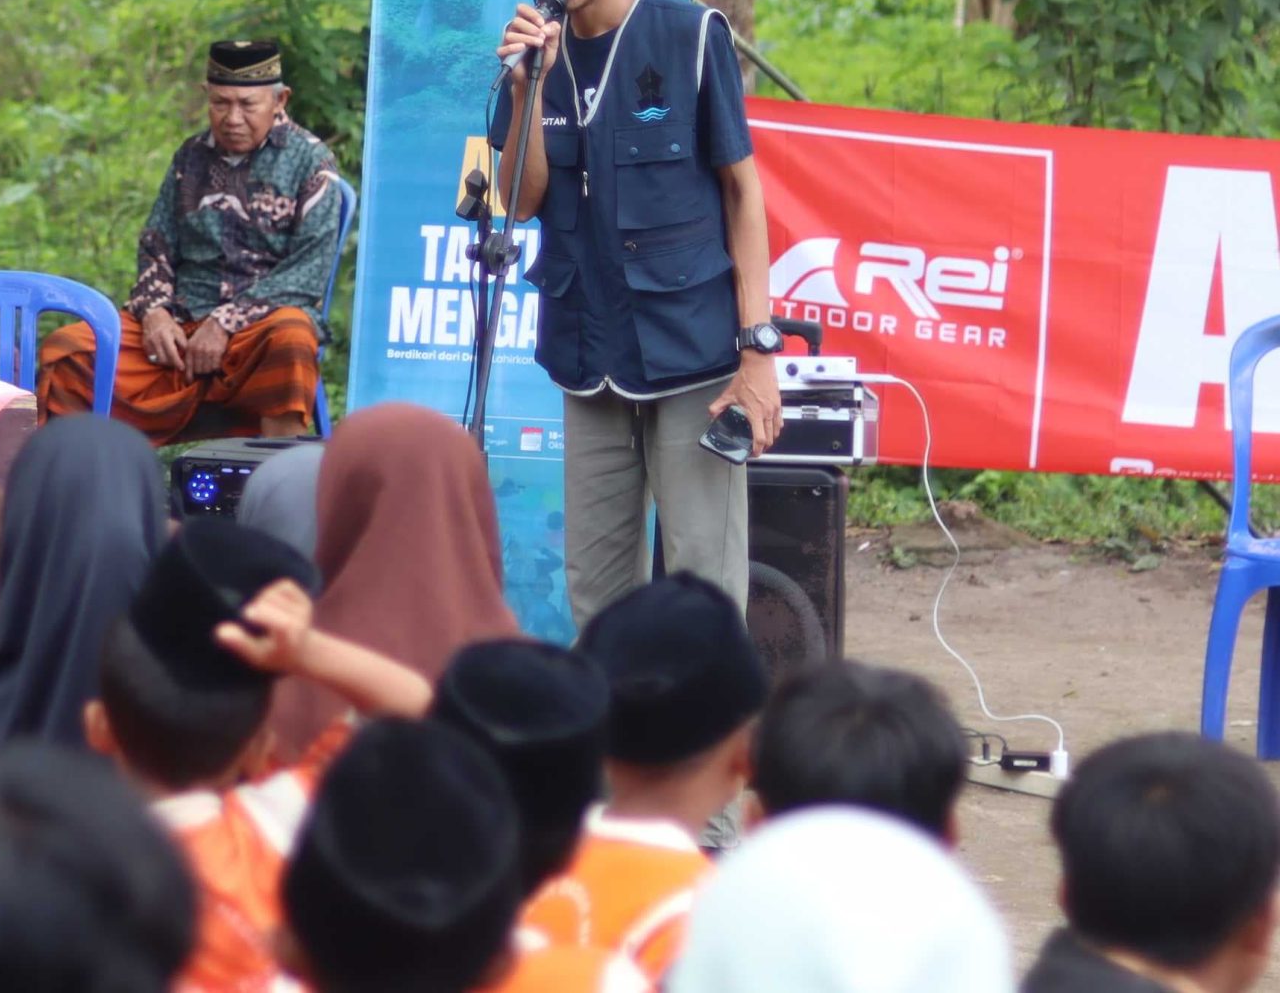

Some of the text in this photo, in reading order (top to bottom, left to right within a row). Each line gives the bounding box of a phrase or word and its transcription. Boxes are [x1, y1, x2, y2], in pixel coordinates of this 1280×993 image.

[769, 298, 1006, 348] TDOOR GEAR
[387, 348, 436, 361] Berdikari
[437, 350, 460, 361] dari
